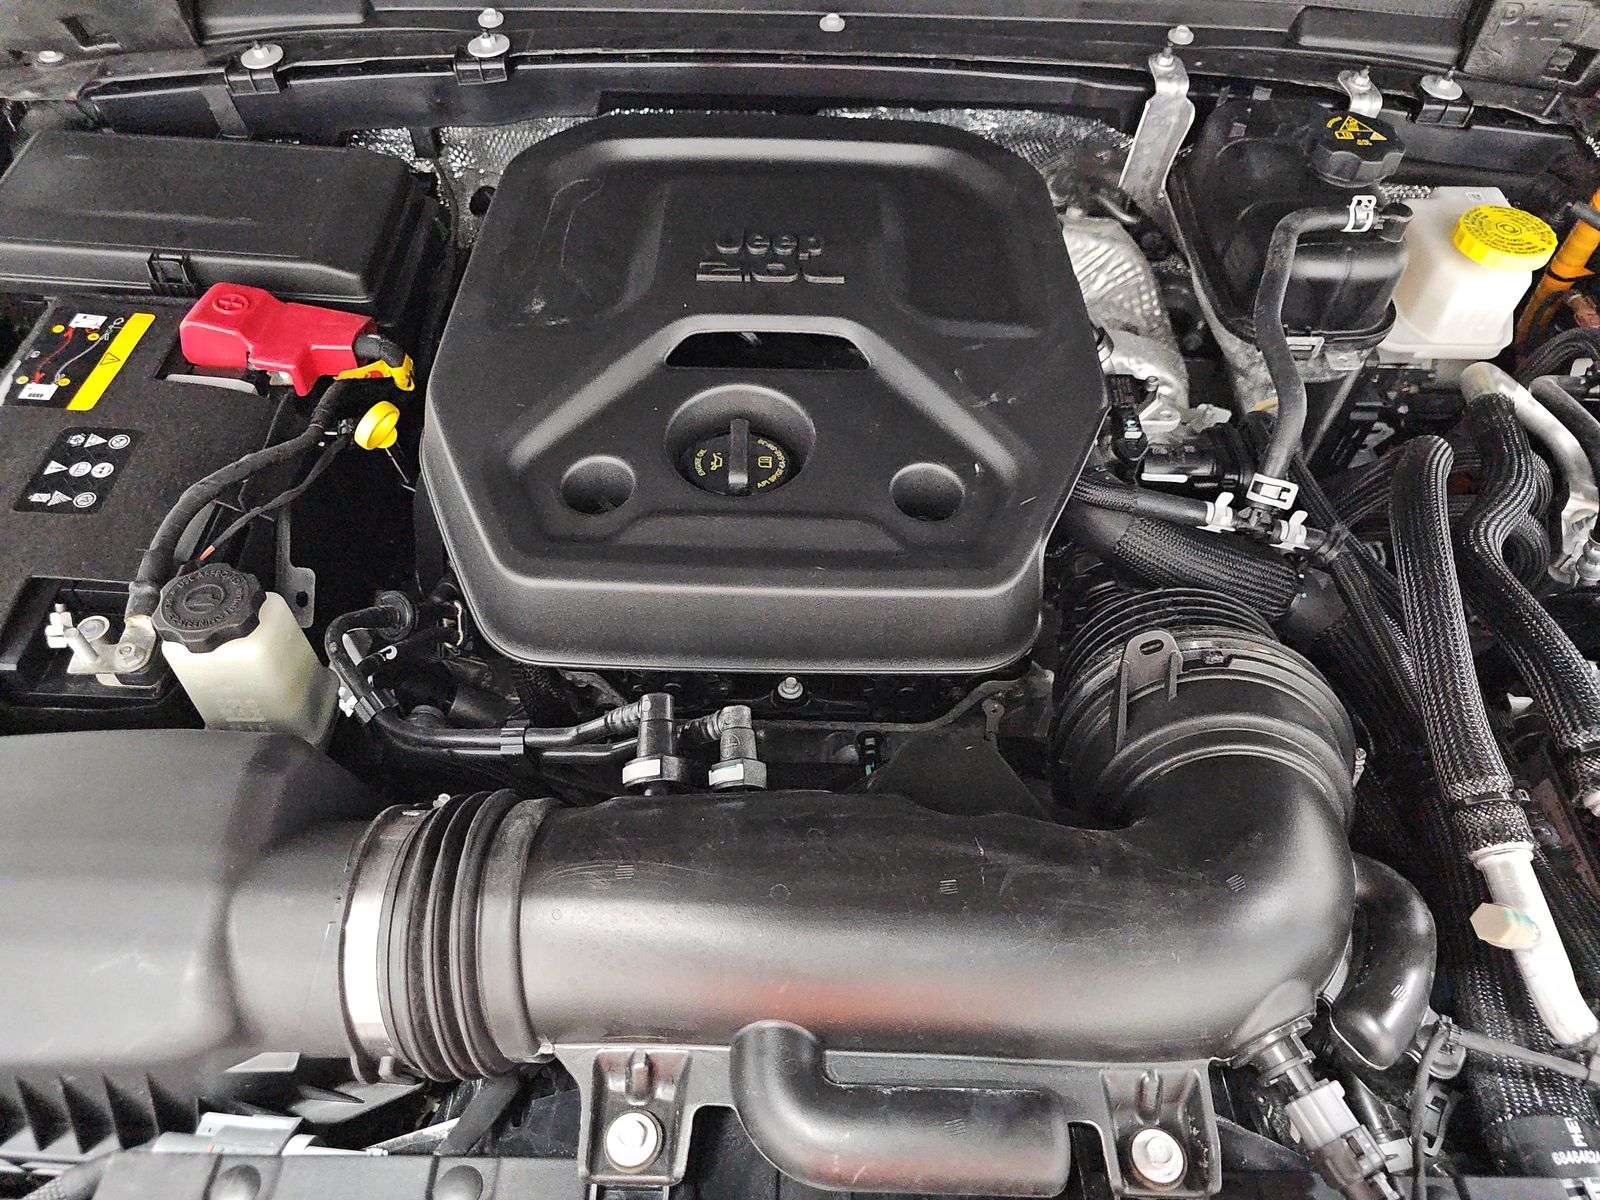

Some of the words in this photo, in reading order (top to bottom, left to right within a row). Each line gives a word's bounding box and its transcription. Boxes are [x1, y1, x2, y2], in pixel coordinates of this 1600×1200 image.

[714, 230, 825, 261] Jeep
[696, 261, 845, 284] 2.0L
[757, 480, 770, 489] API
